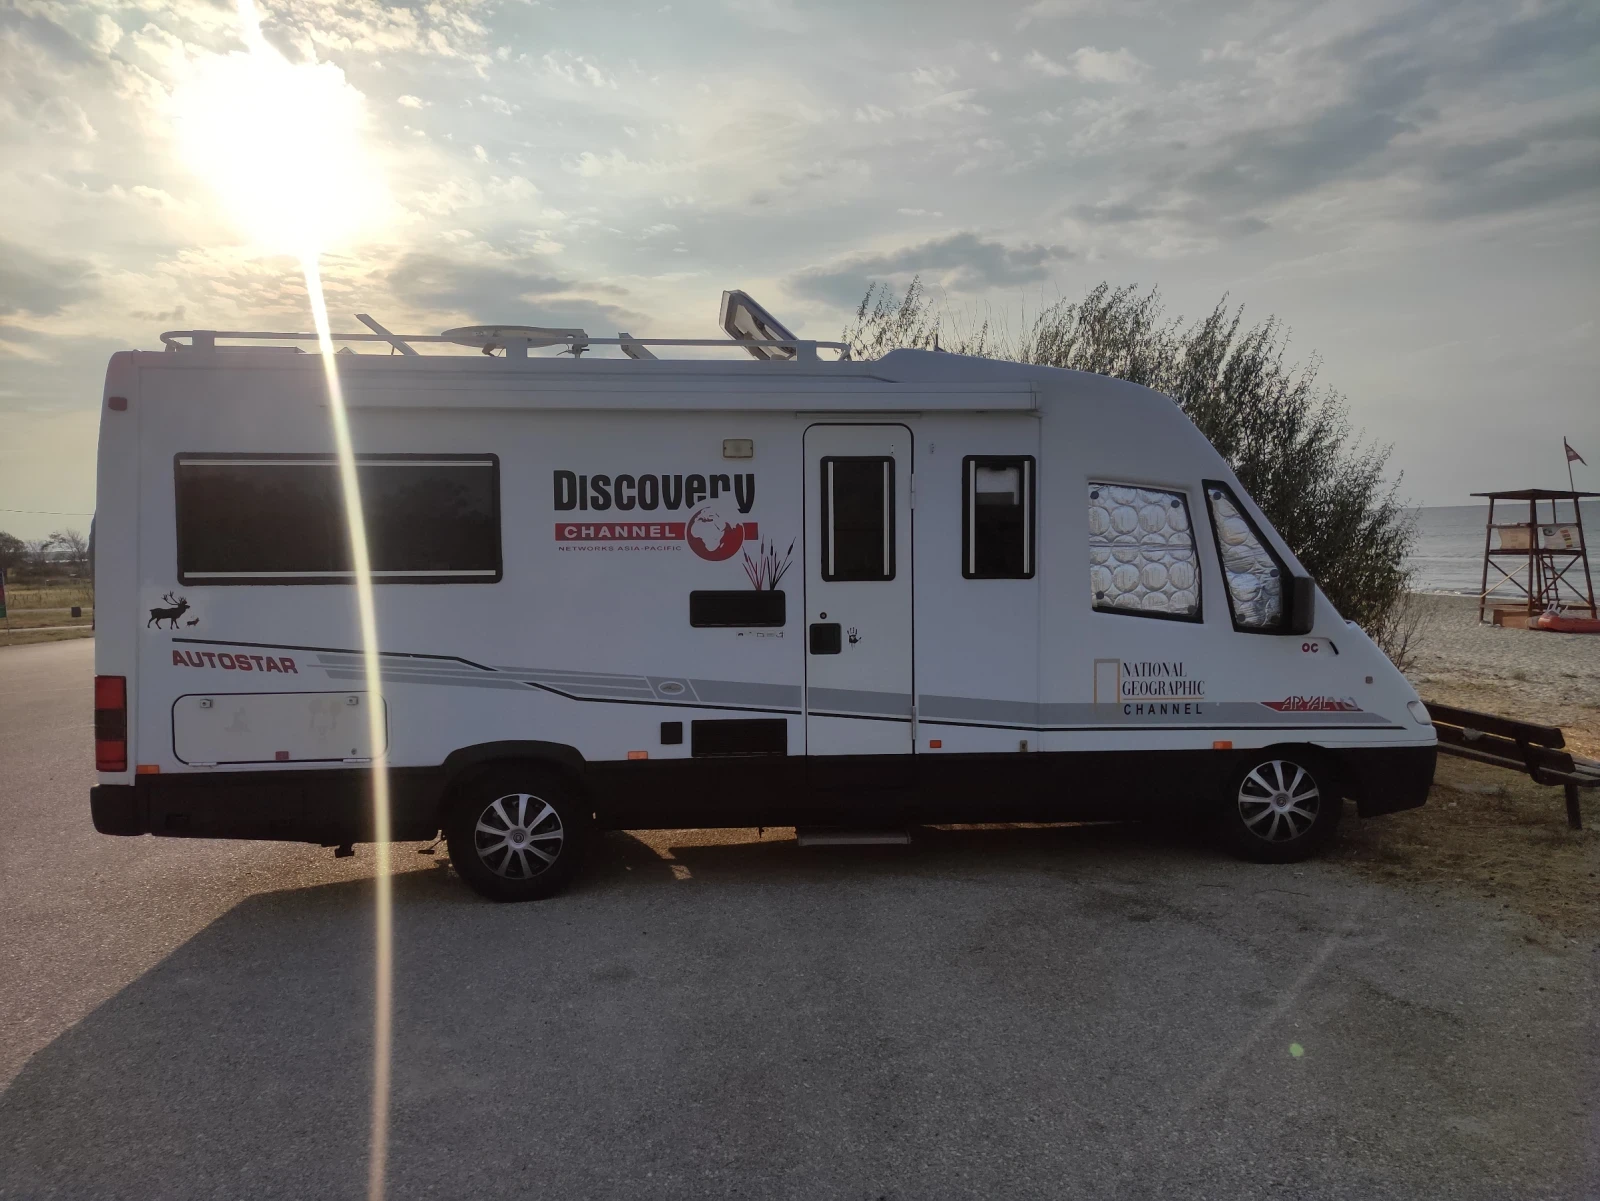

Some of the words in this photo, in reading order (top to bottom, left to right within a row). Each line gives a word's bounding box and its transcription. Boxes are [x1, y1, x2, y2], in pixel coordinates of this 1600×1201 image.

[564, 526, 675, 538] CHANNEL
[172, 650, 298, 674] AUTOSTAR
[1122, 661, 1187, 678] NATIONAL
[1122, 680, 1205, 697] GEOGRAPHIC
[1124, 703, 1203, 716] CHANNEL
